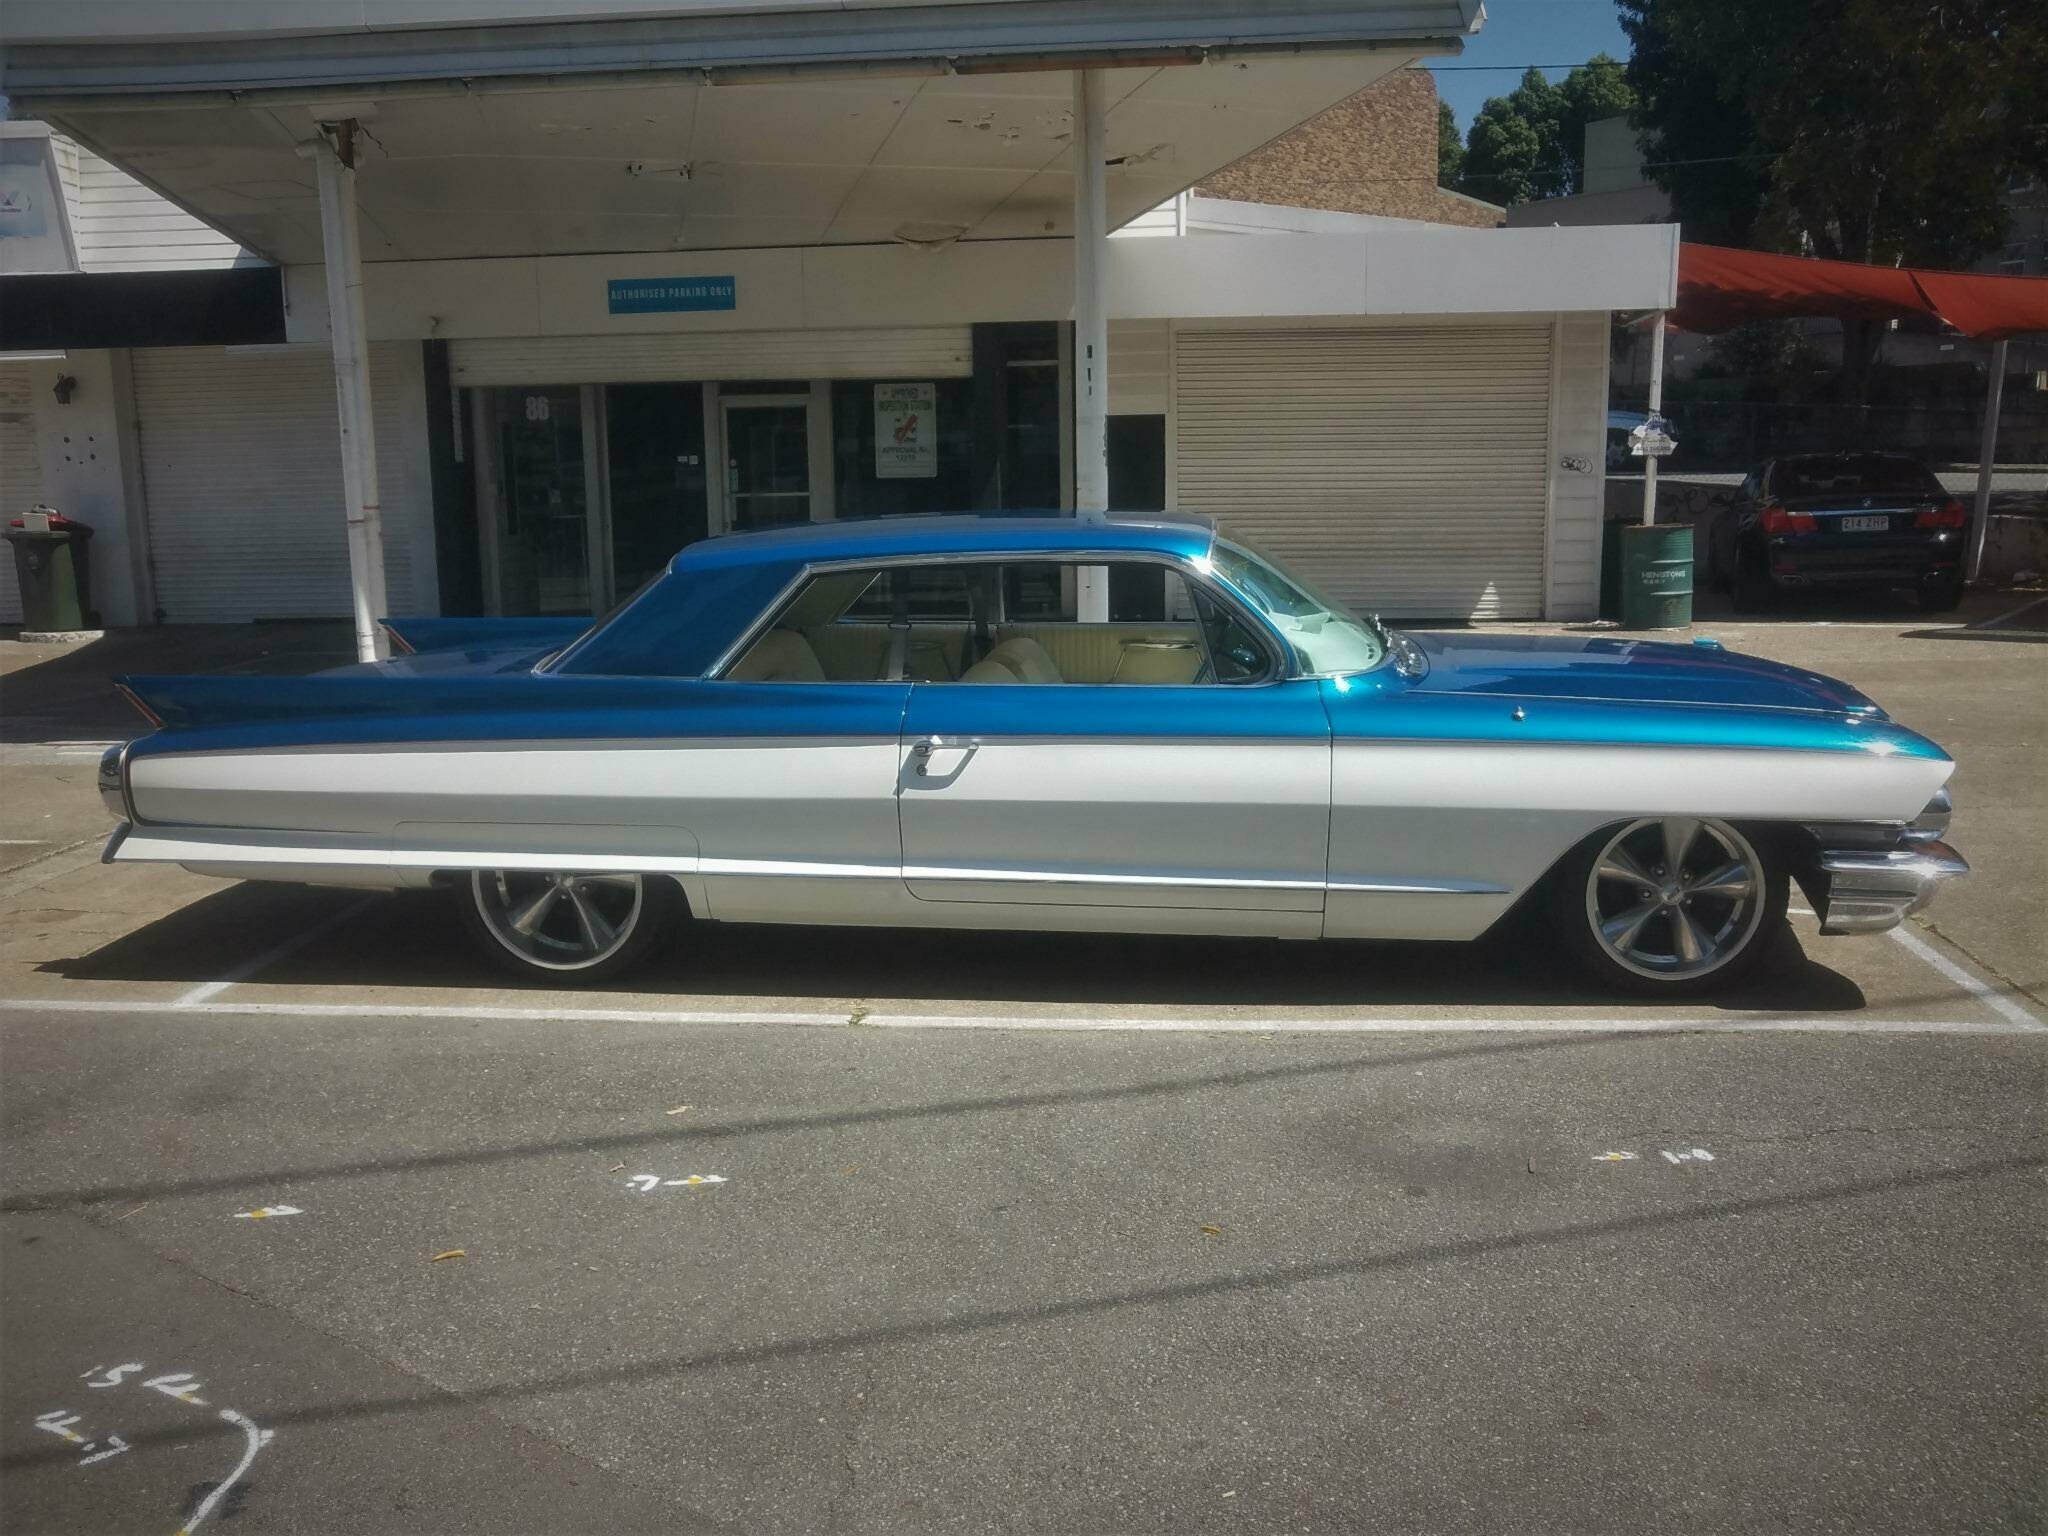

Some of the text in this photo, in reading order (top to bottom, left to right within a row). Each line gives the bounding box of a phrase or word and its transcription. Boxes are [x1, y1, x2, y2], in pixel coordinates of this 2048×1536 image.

[611, 286, 733, 299] AUTHORISED PARKING ONLY
[526, 396, 550, 420] 86
